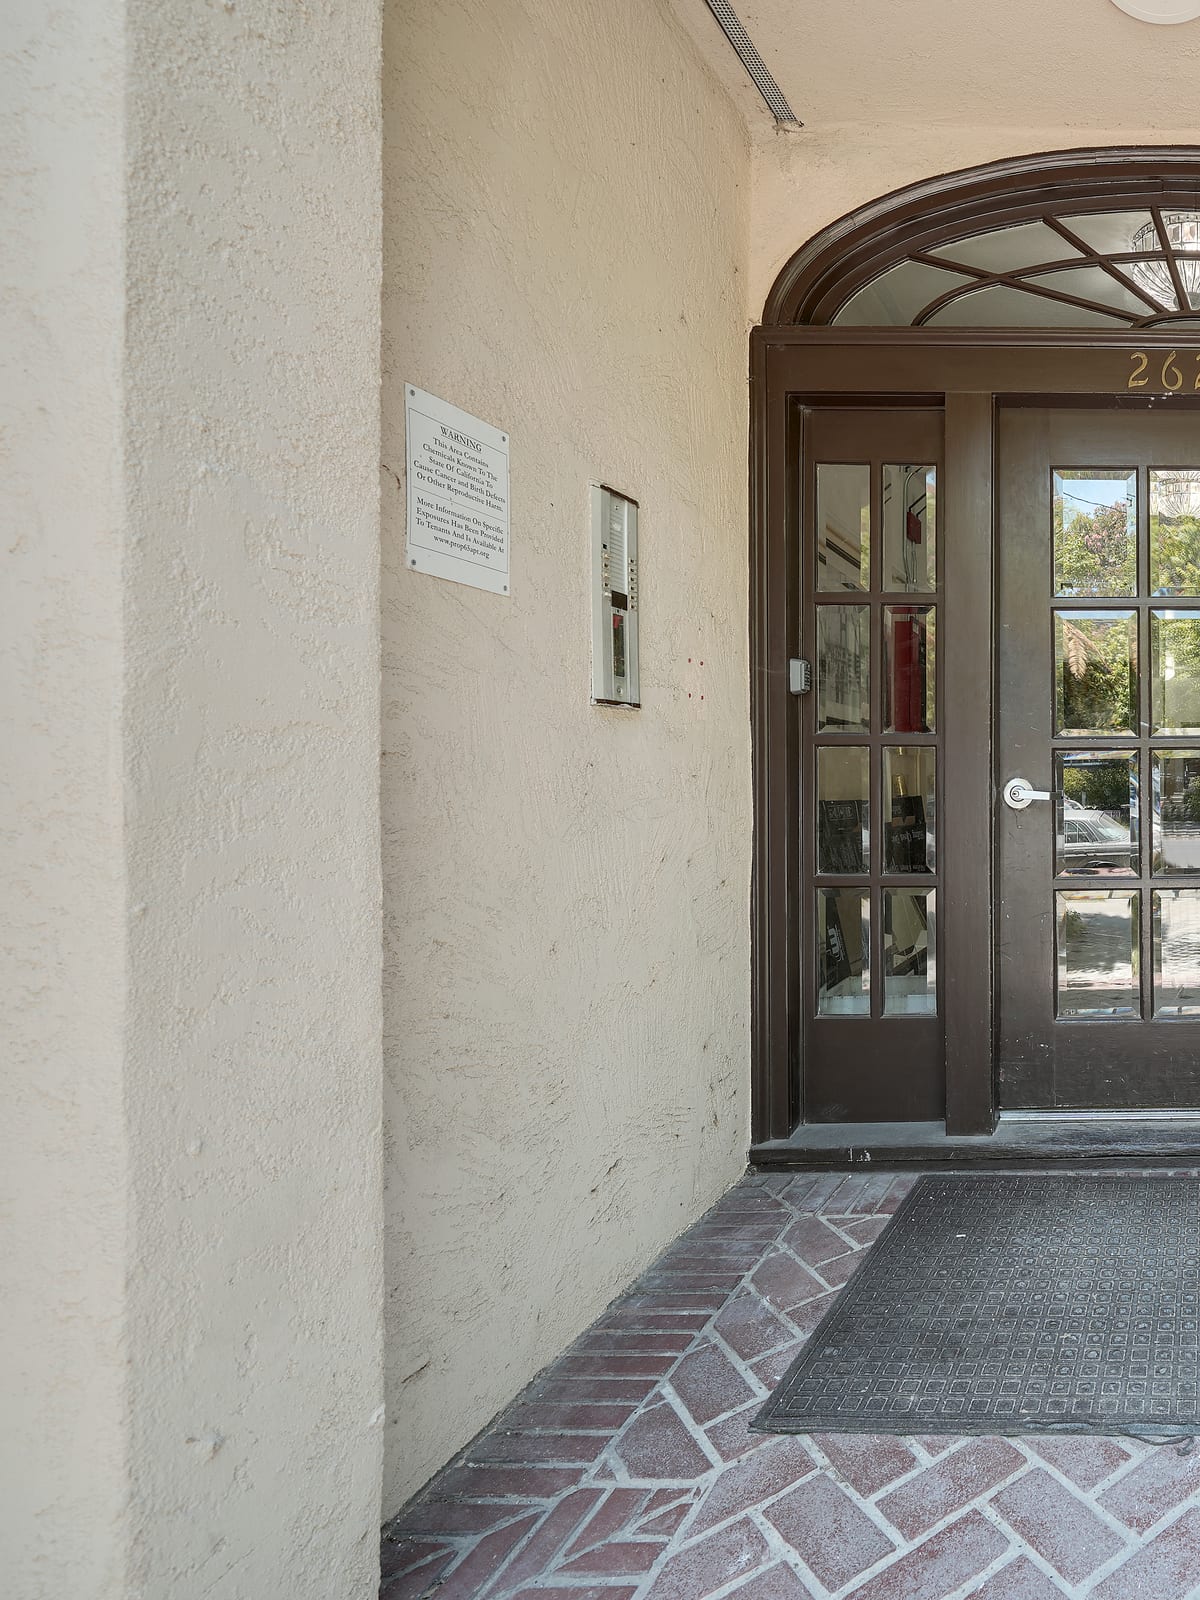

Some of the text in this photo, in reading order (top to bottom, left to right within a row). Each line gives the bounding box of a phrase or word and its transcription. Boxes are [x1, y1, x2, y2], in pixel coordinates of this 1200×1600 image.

[433, 436, 488, 468] This Area Contains
[440, 426, 481, 451] WARNING
[423, 443, 497, 482] Chemicals Known To The
[428, 456, 493, 489] State Of California To
[413, 460, 505, 503] Cause Cancer and Birth Defects
[417, 471, 503, 512] Or Other Reproductive Harm.
[416, 507, 504, 544] Exposures Has Been Provided
[416, 516, 425, 526] To
[426, 520, 451, 535] Tenants
[452, 530, 465, 540] And
[473, 537, 497, 551] Available
[417, 496, 503, 534] More Information On Specific
